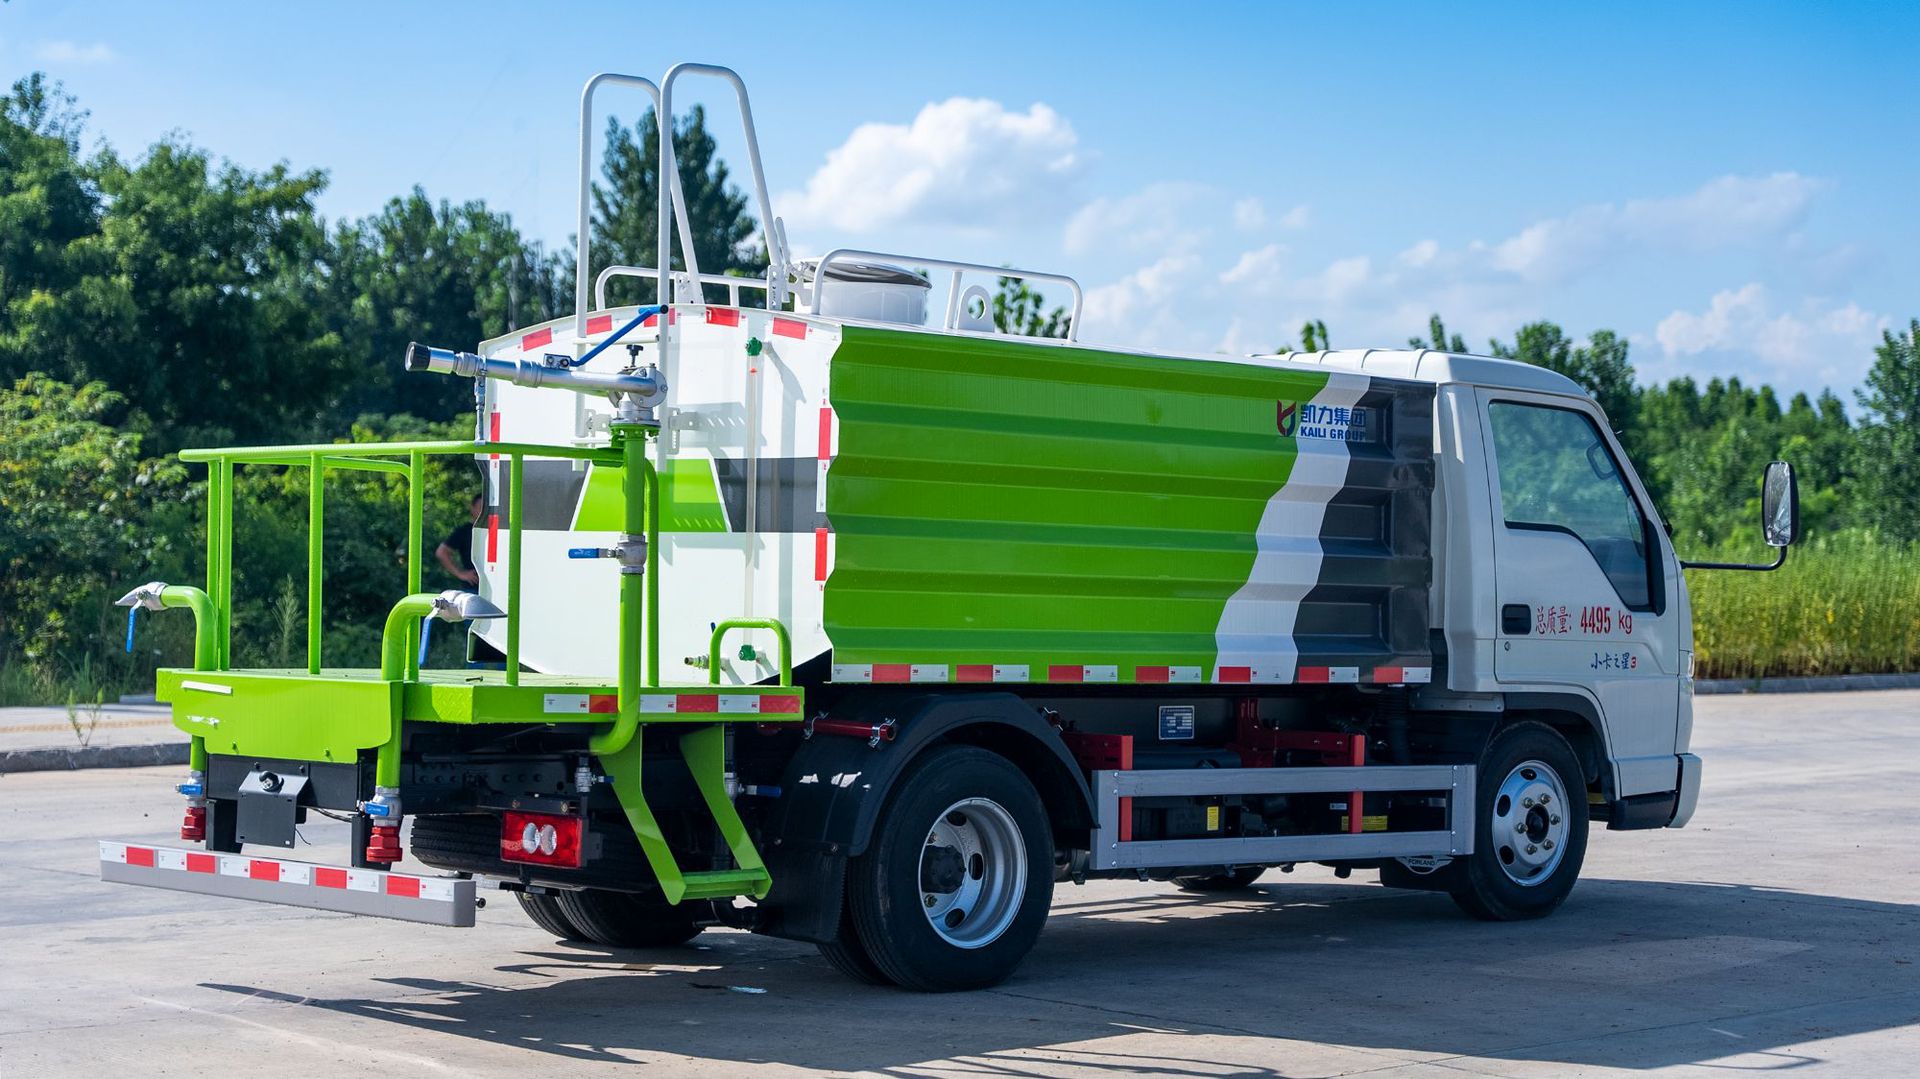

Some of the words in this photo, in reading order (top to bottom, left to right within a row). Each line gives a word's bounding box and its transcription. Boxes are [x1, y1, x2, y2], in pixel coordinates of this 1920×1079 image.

[1301, 404, 1366, 427] 凯力集团
[1301, 426, 1327, 438] KAILI
[1330, 429, 1366, 440] GROUP
[1580, 606, 1611, 634] 4495
[1618, 610, 1632, 634] kg
